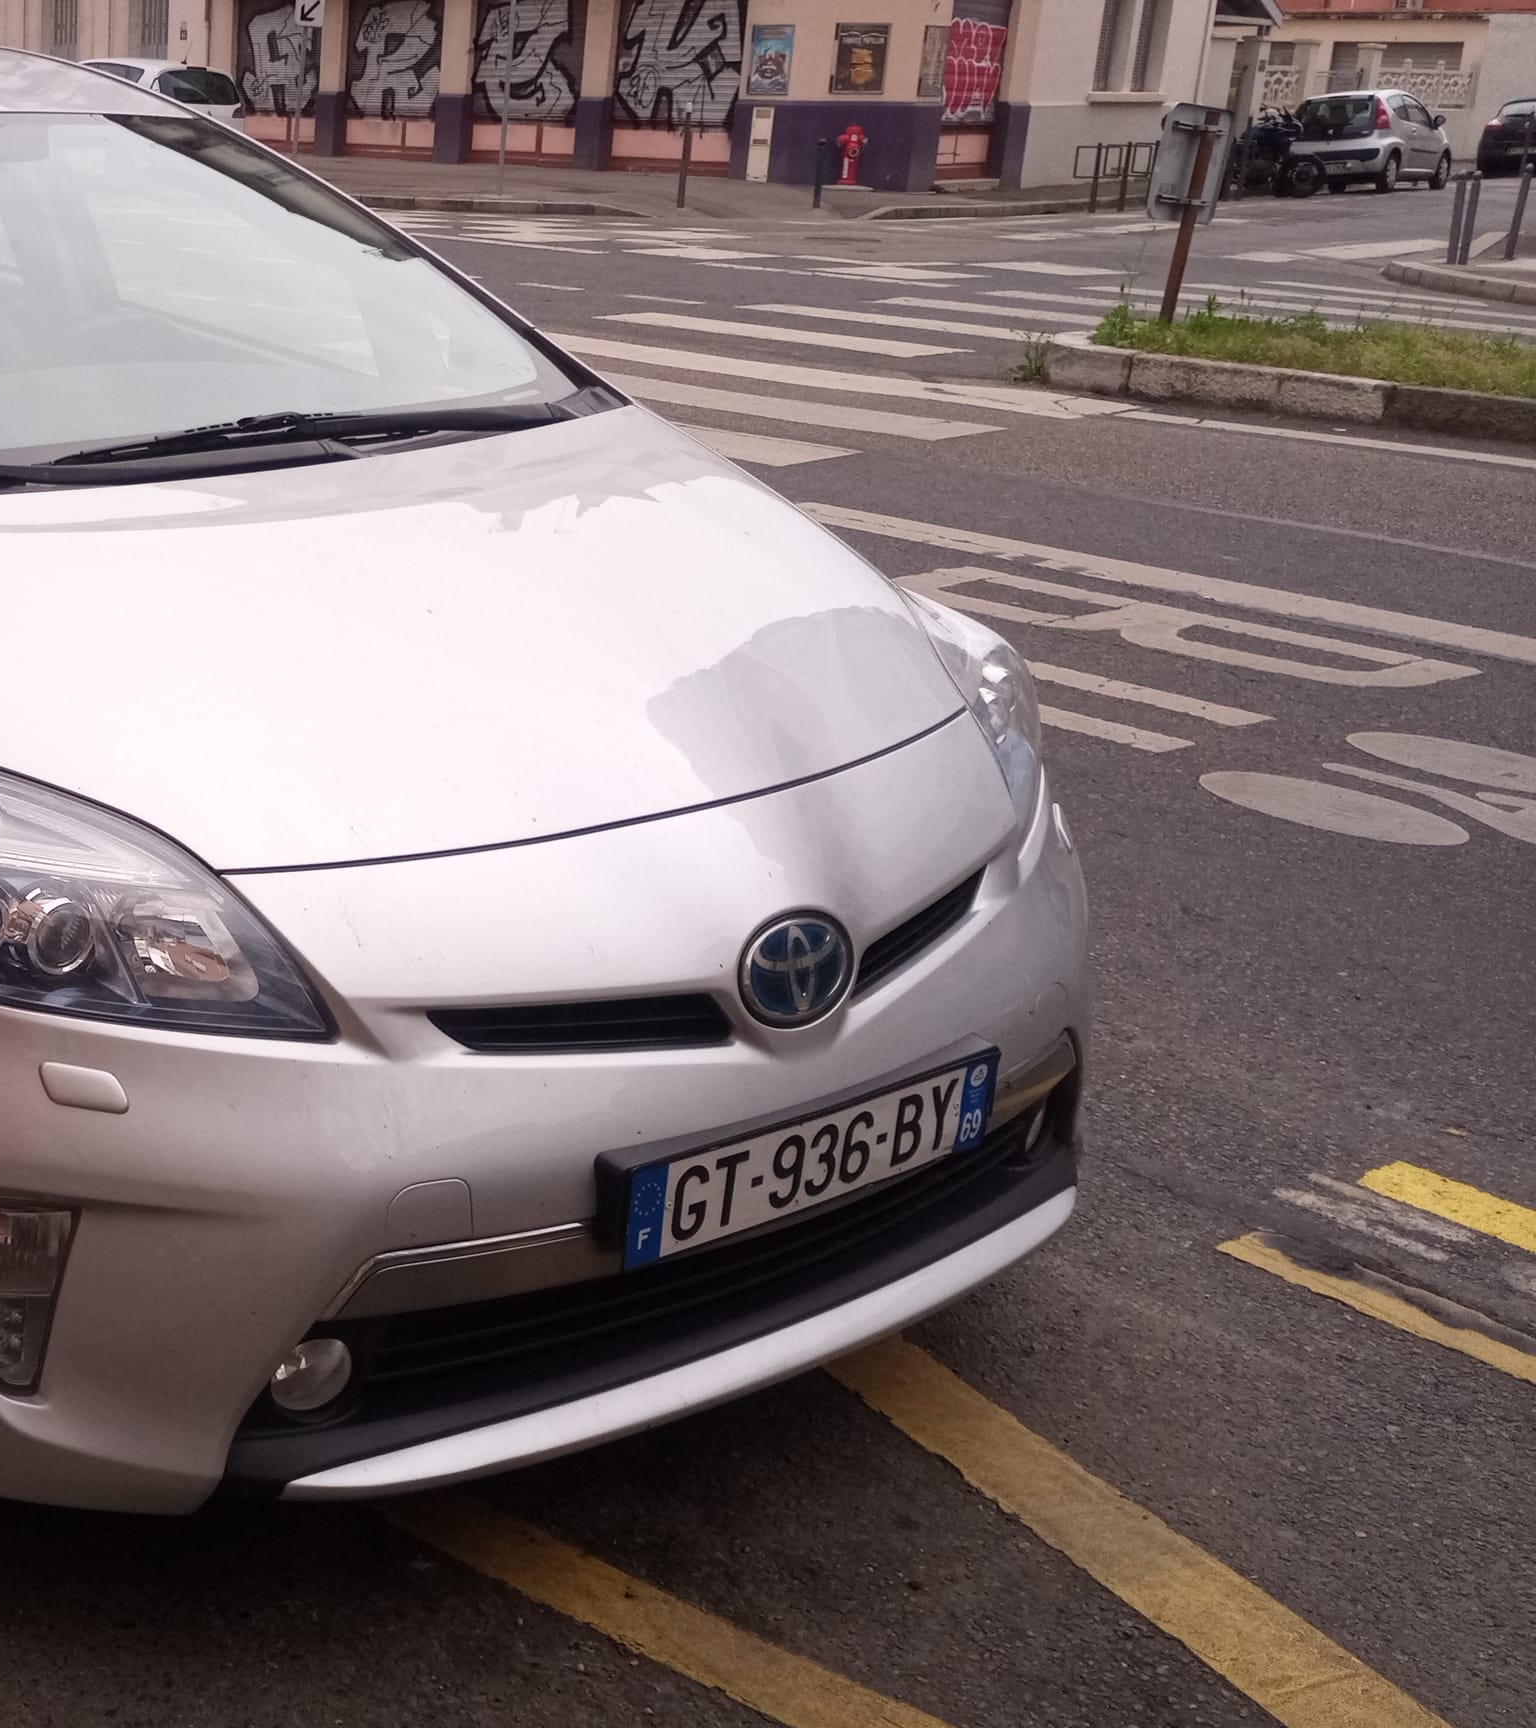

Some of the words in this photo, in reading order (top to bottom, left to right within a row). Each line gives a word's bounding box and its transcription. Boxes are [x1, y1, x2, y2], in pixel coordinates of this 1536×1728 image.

[960, 1108, 982, 1142] 69
[671, 1078, 959, 1241] GT-936-BY
[636, 1228, 651, 1250] F
